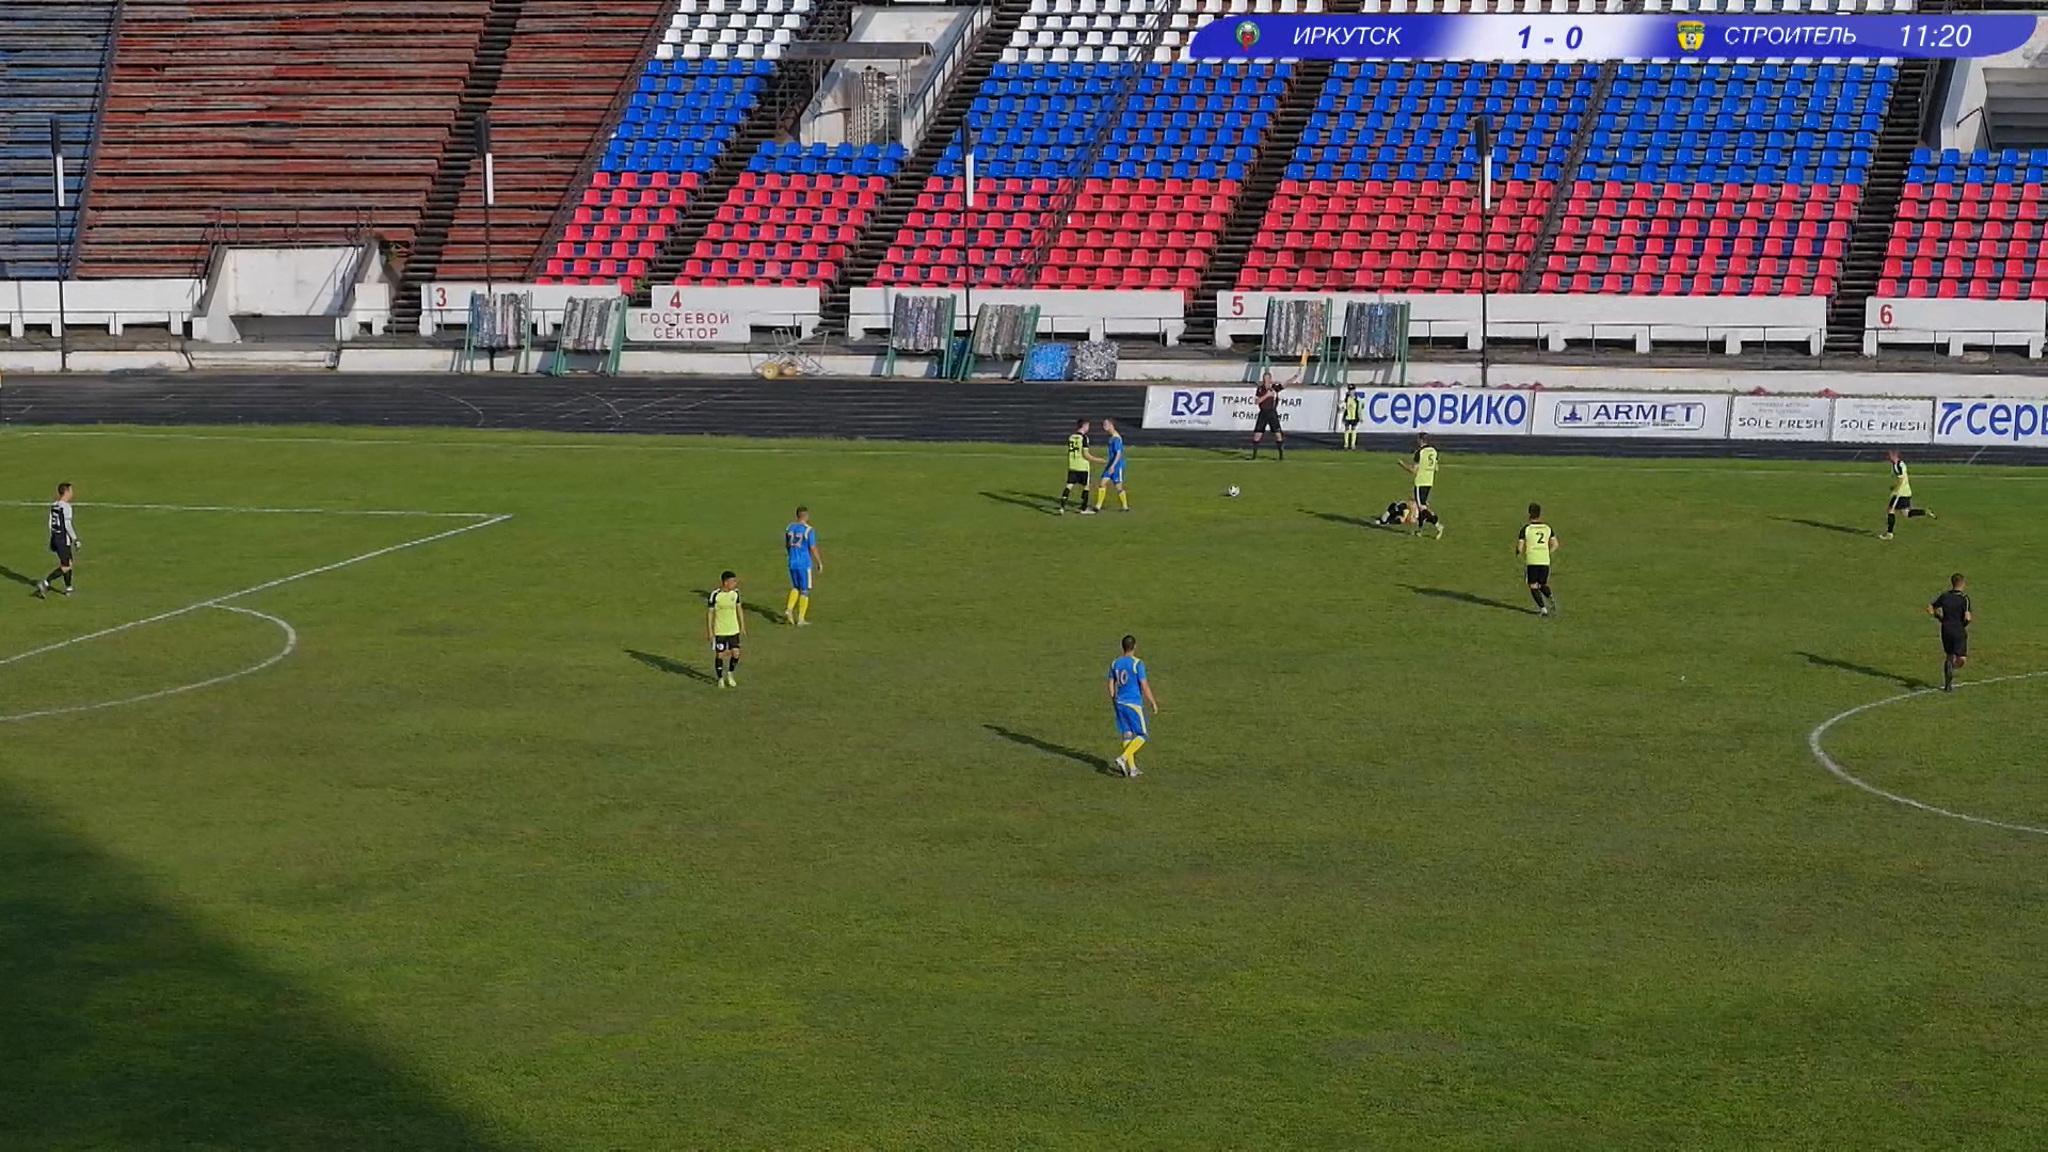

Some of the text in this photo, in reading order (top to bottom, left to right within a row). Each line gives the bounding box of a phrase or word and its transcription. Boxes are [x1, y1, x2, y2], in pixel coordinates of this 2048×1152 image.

[435, 287, 447, 307] 3
[669, 290, 682, 309] 4
[1232, 295, 1244, 316] 5
[1880, 304, 1893, 325] 6
[653, 328, 718, 339] СЕКТОР
[1369, 391, 1526, 428] сервико
[1593, 404, 1698, 423] ARMET
[1738, 417, 1824, 429] SOLE FRESH
[1840, 419, 1875, 431] SOLE
[1535, 532, 1546, 544] 2
[1115, 669, 1128, 685] 10
